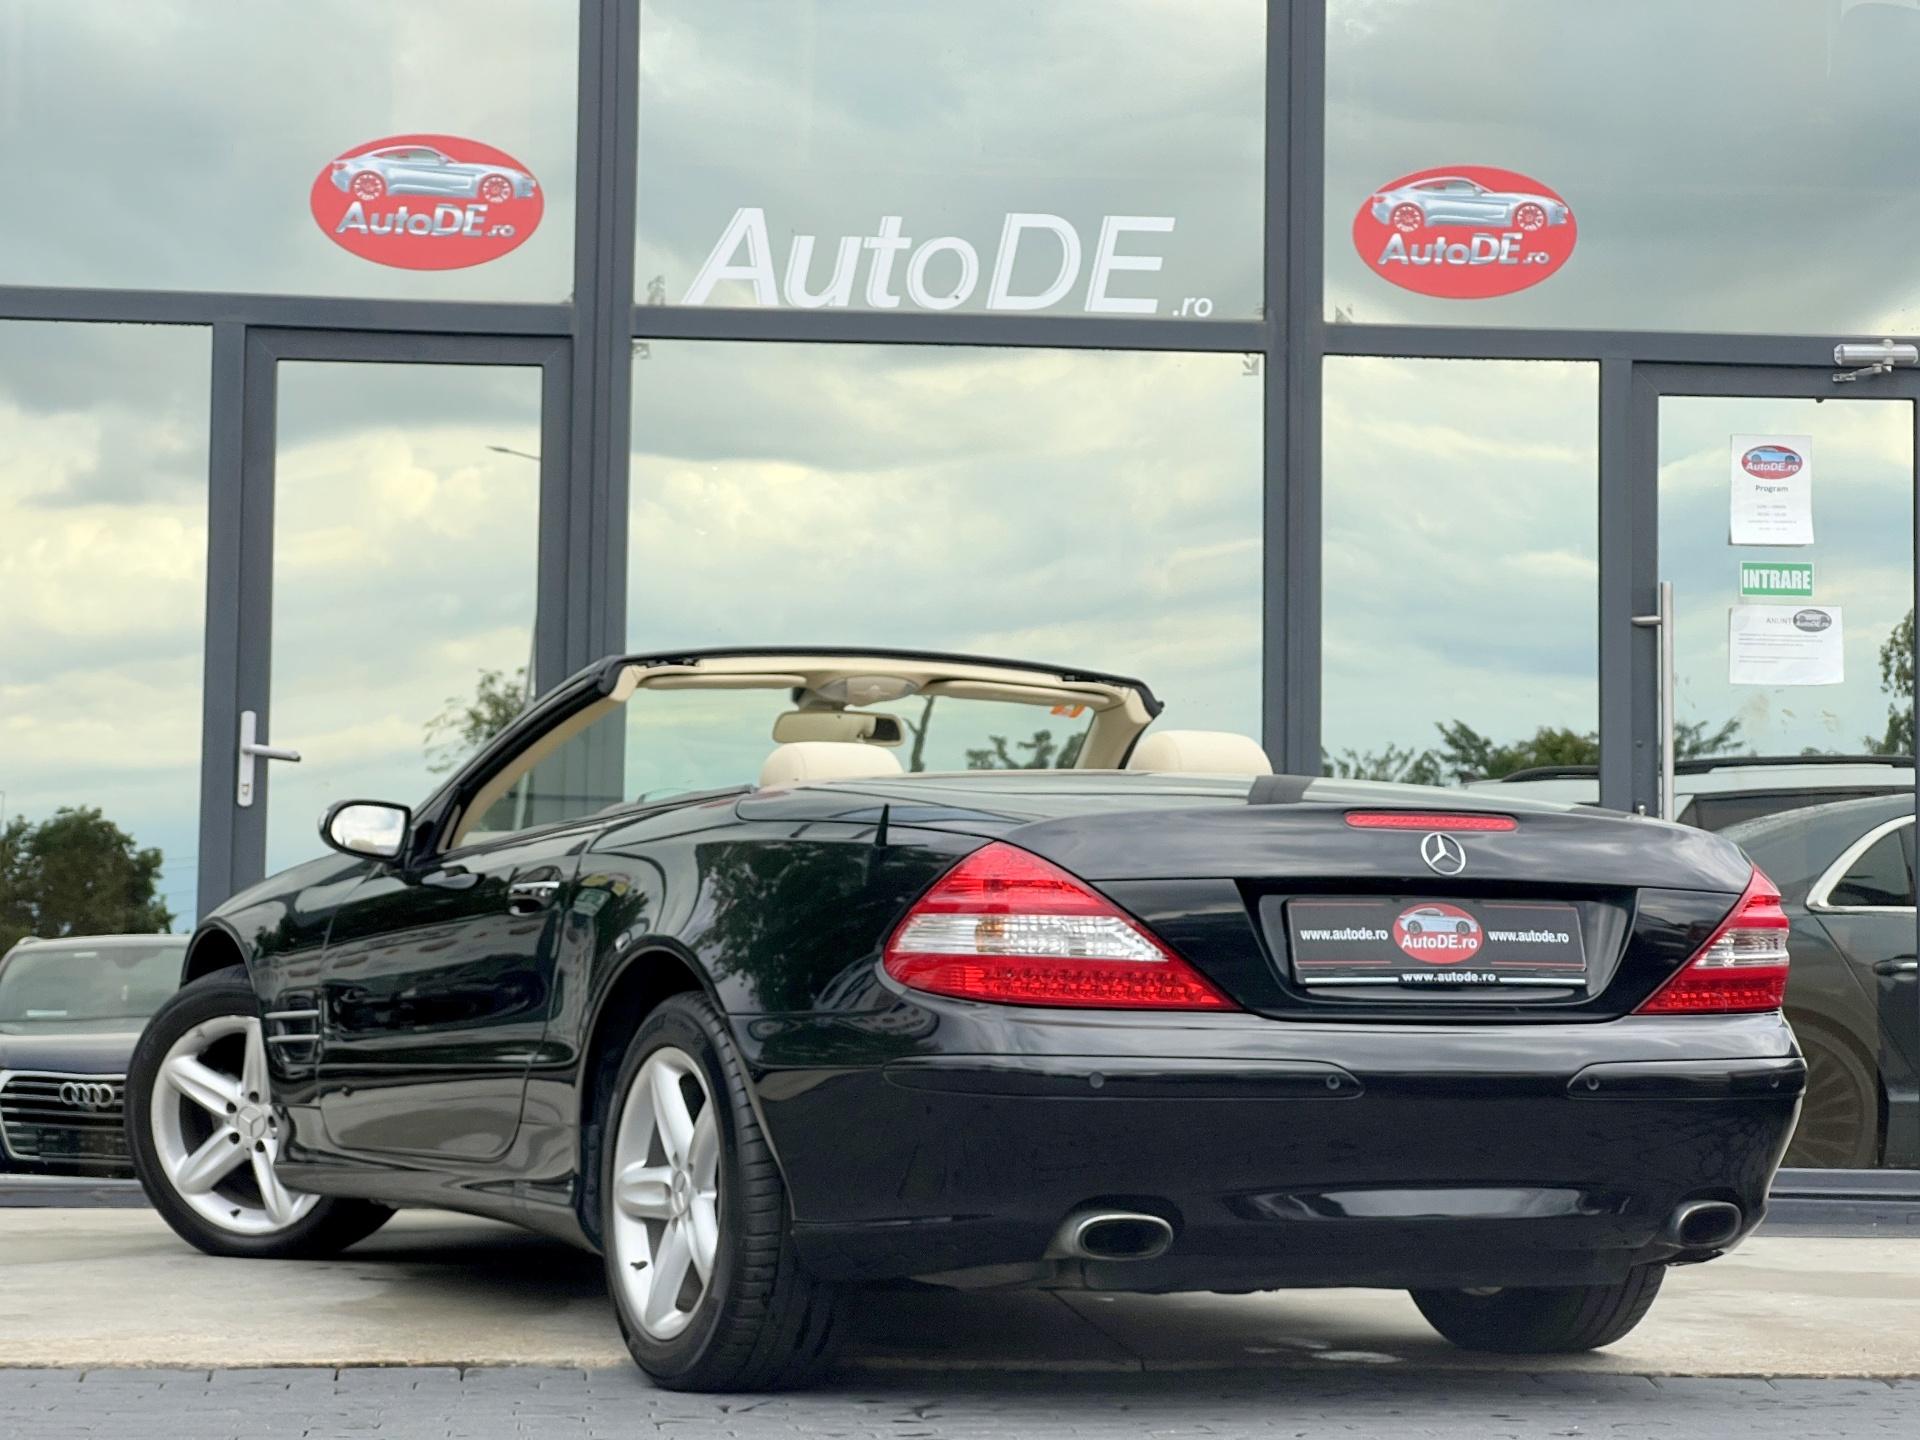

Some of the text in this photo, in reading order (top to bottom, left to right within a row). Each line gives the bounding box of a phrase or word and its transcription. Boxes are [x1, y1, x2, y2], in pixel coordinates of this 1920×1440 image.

[1755, 485, 1789, 494] Program
[1743, 569, 1811, 590] INTRARE
[1300, 927, 1389, 941] www.autode.ro
[1488, 930, 1570, 943] www.autode.ro
[1402, 934, 1478, 949] AutoDE.ro
[1402, 971, 1496, 983] www.autode.ro
